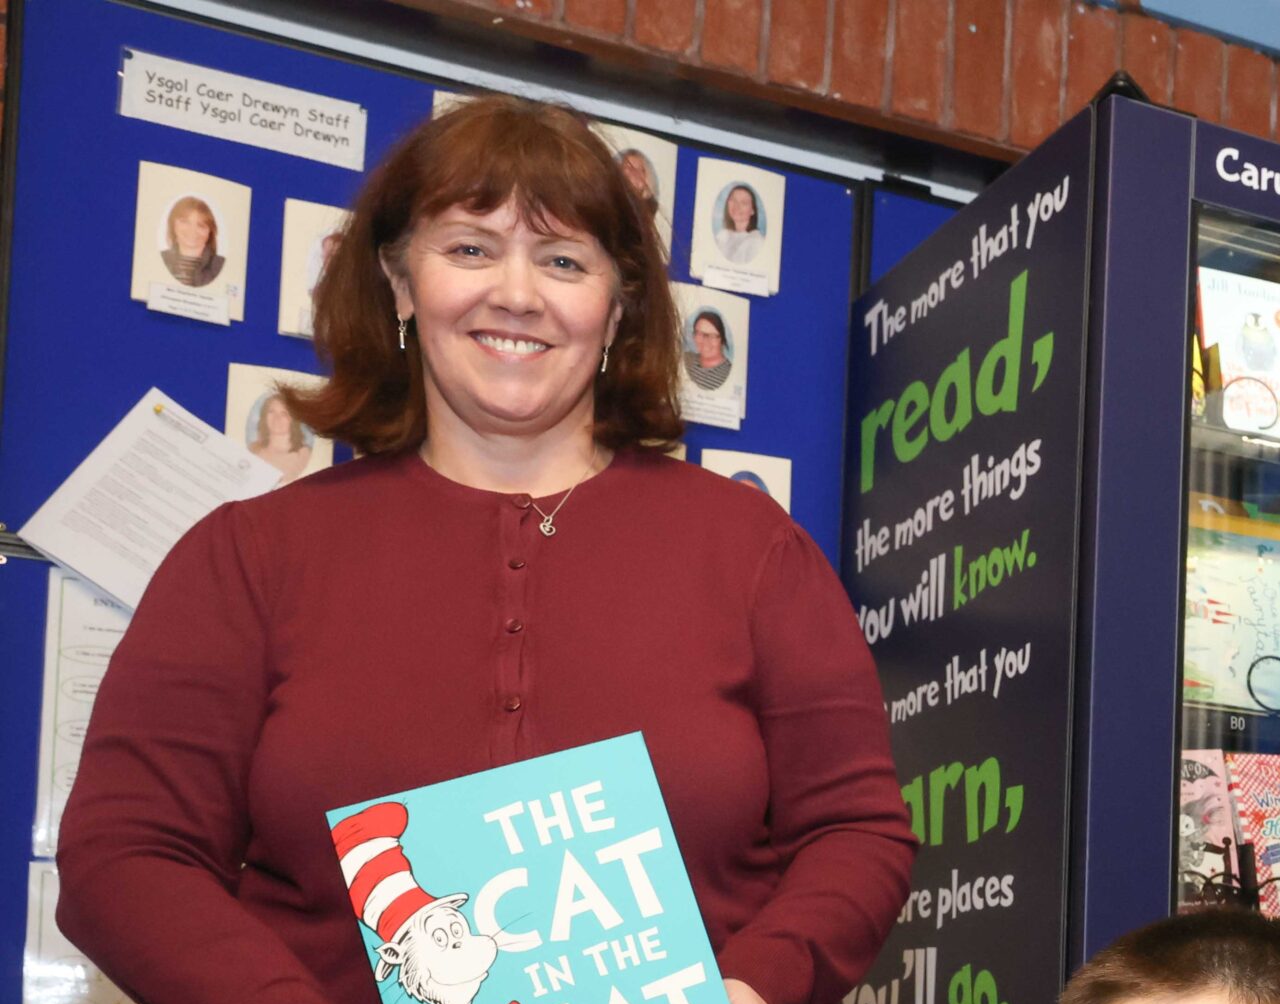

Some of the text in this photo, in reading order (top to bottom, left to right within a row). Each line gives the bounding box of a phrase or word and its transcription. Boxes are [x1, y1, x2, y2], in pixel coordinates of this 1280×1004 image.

[145, 71, 350, 129] Ysgol Caer Drewyn Staff
[145, 91, 350, 148] Staff Ysgol Caer Drewyn
[865, 175, 1069, 356] The more that you
[860, 268, 1053, 494] read,
[855, 438, 1042, 572] the more things
[900, 529, 1036, 626] will know.
[892, 642, 1031, 723] more that you
[483, 780, 616, 855] THE
[472, 826, 665, 953] CAT
[936, 869, 1014, 929] places
[524, 926, 668, 999] IN THE
